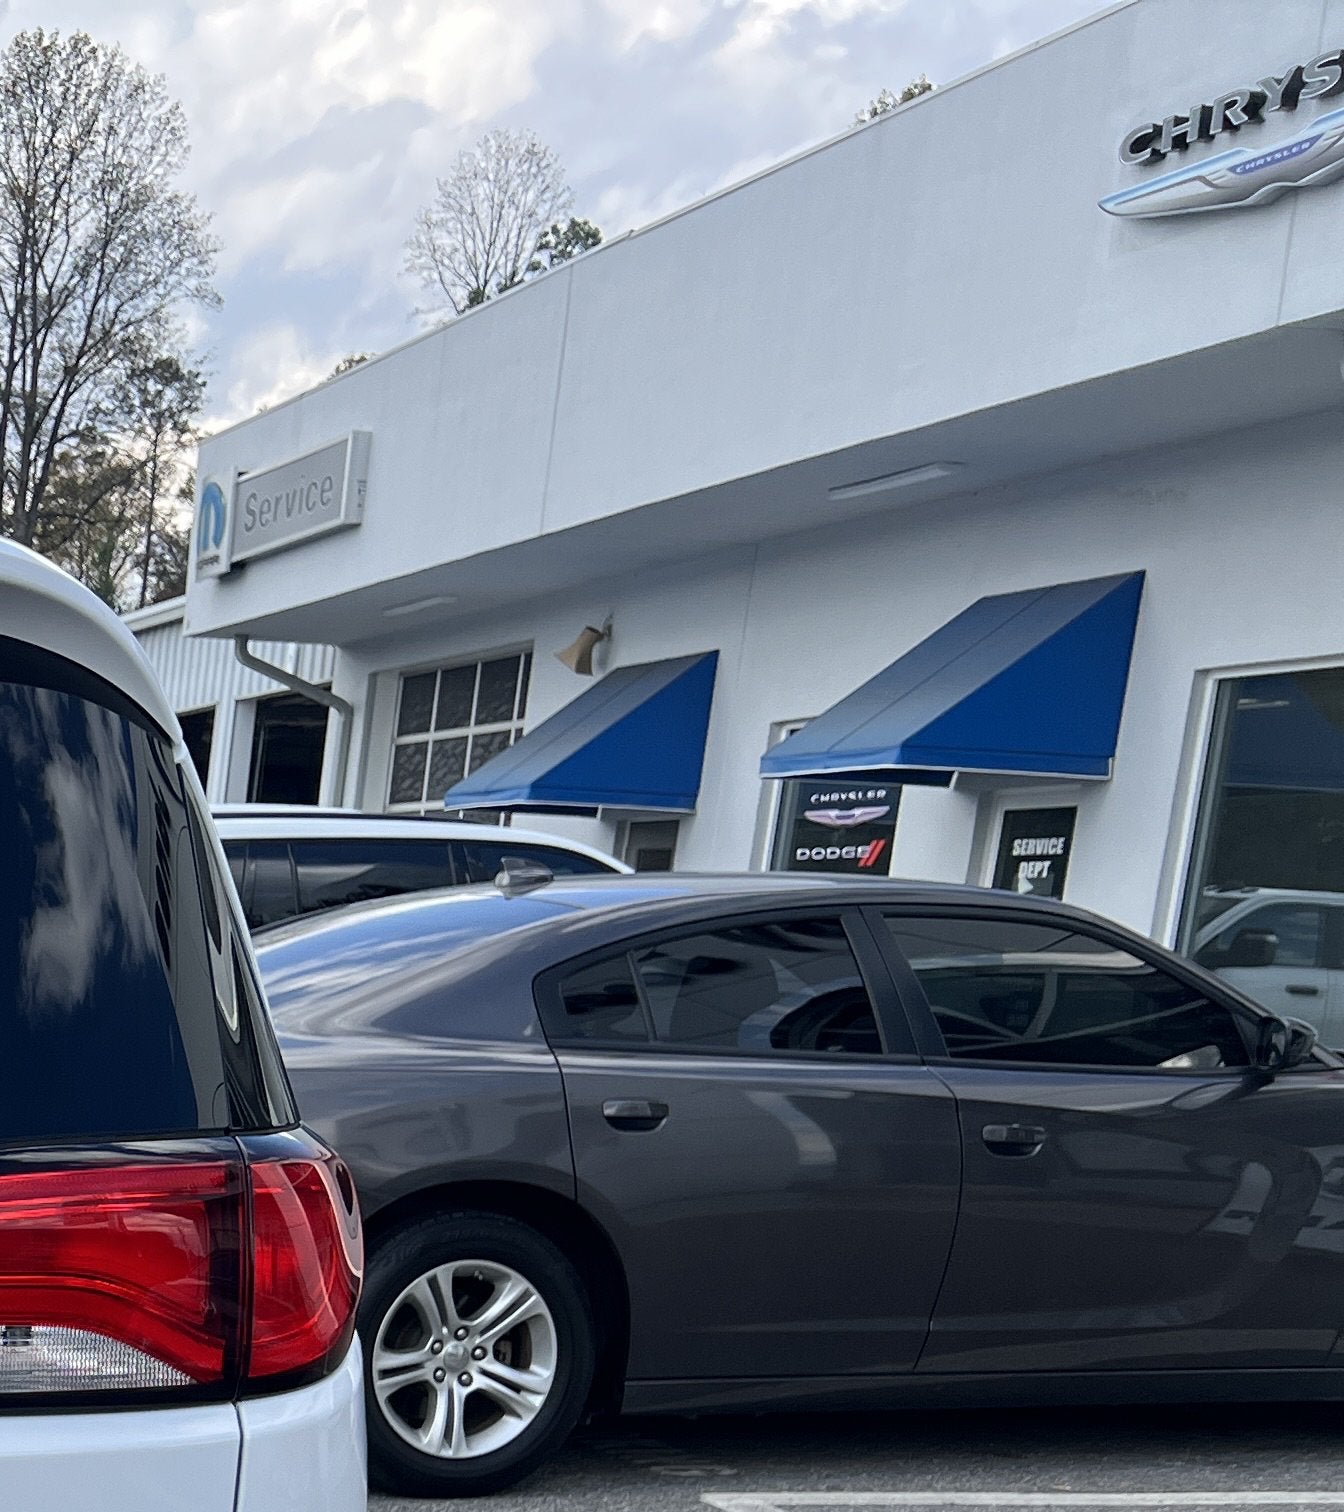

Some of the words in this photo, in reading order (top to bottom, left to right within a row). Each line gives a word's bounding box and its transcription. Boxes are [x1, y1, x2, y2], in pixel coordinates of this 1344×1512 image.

[1118, 49, 1344, 165] CHRYS
[1236, 142, 1310, 173] CHRYSLER
[244, 475, 333, 532] Service
[810, 789, 887, 804] CHRYSLER
[796, 845, 871, 860] DODGE
[1012, 837, 1065, 856] SERVICE
[1018, 861, 1051, 878] DEPT
